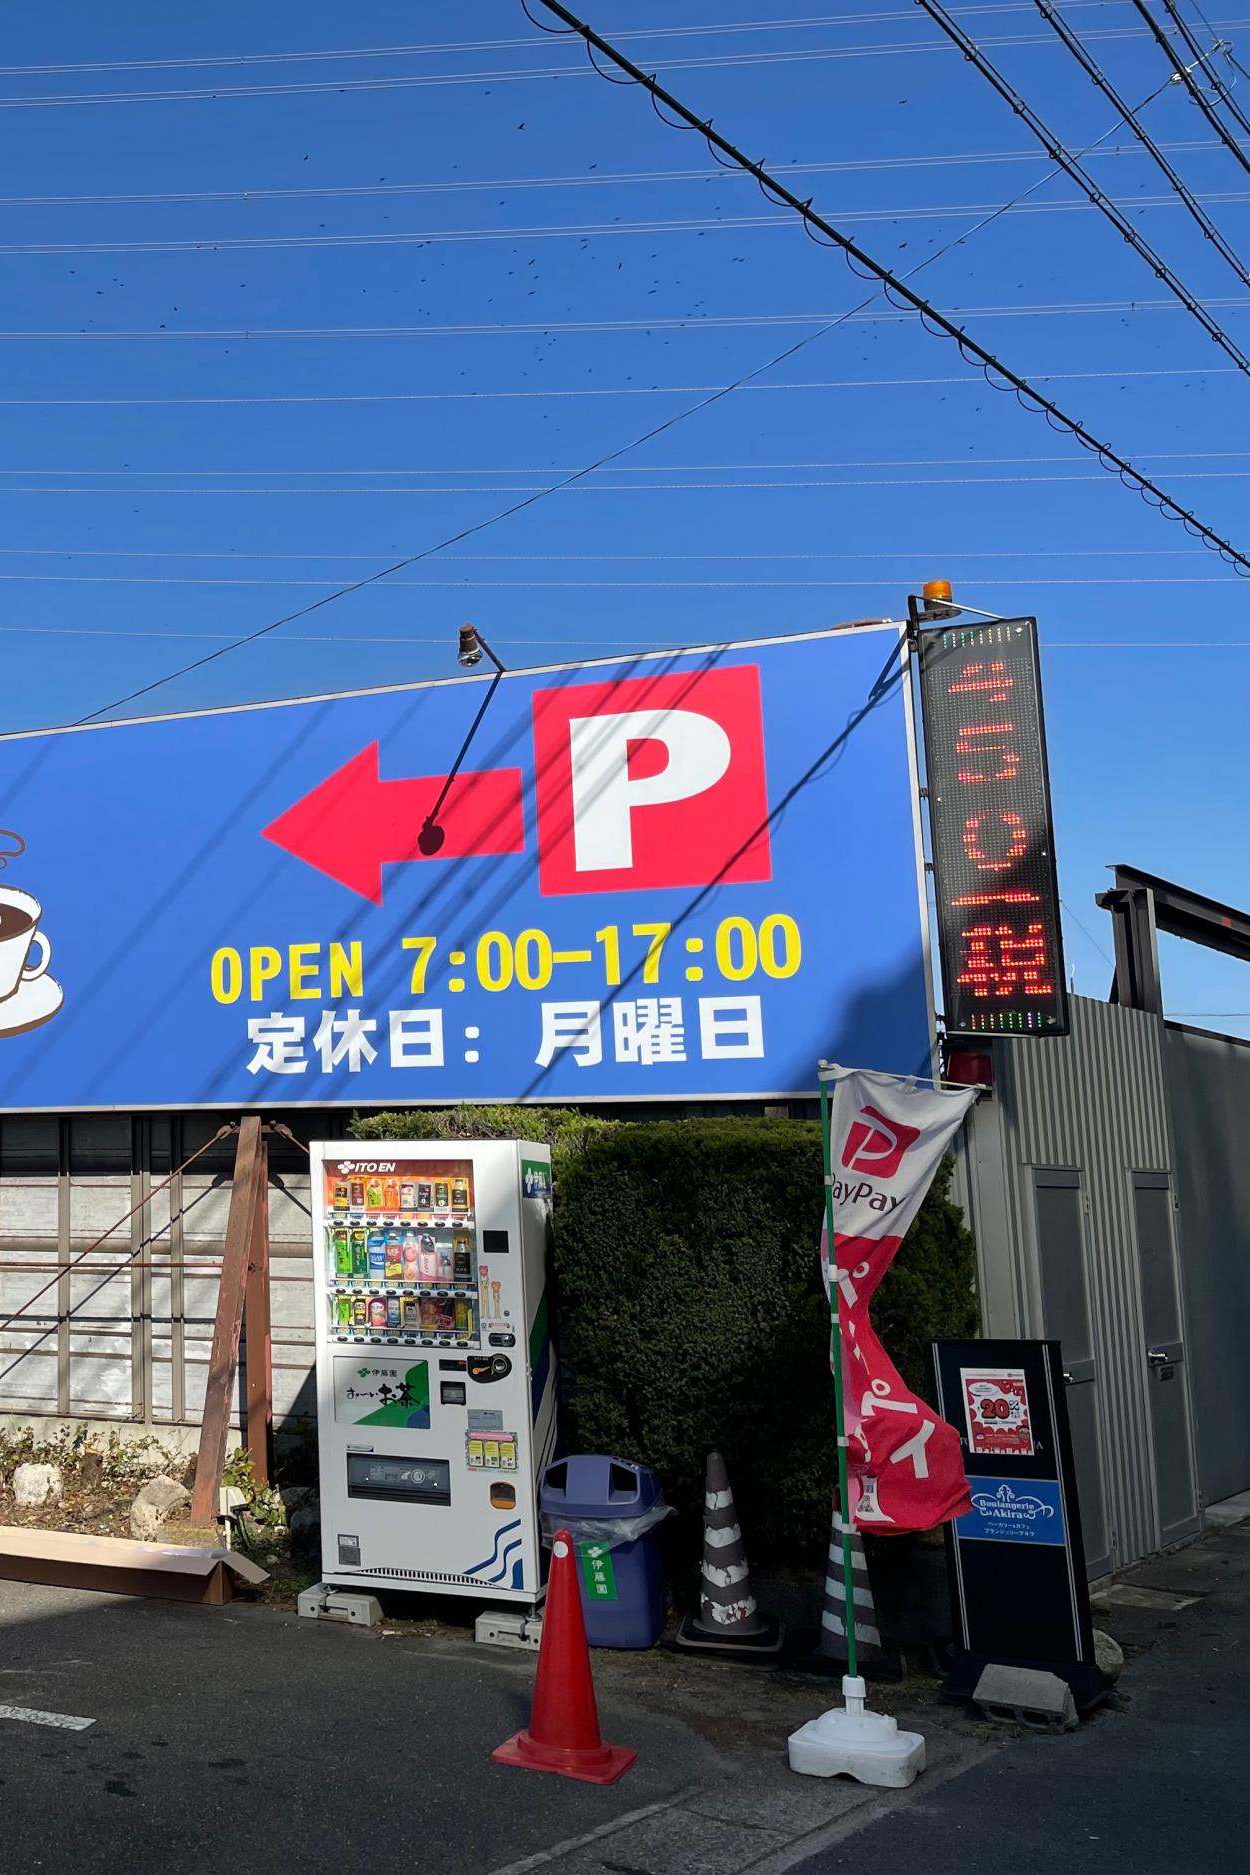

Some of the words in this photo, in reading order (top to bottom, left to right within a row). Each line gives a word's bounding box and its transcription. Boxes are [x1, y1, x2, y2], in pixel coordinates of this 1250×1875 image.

[568, 708, 732, 873] P
[210, 940, 364, 1005] OPEN
[534, 995, 765, 1068] 月曜日
[354, 1162, 377, 1173] ITO
[378, 1162, 396, 1173] EN
[832, 1172, 908, 1212] ayPay
[979, 1499, 1035, 1511] Boulangerie
[992, 1508, 1024, 1520] Akira
